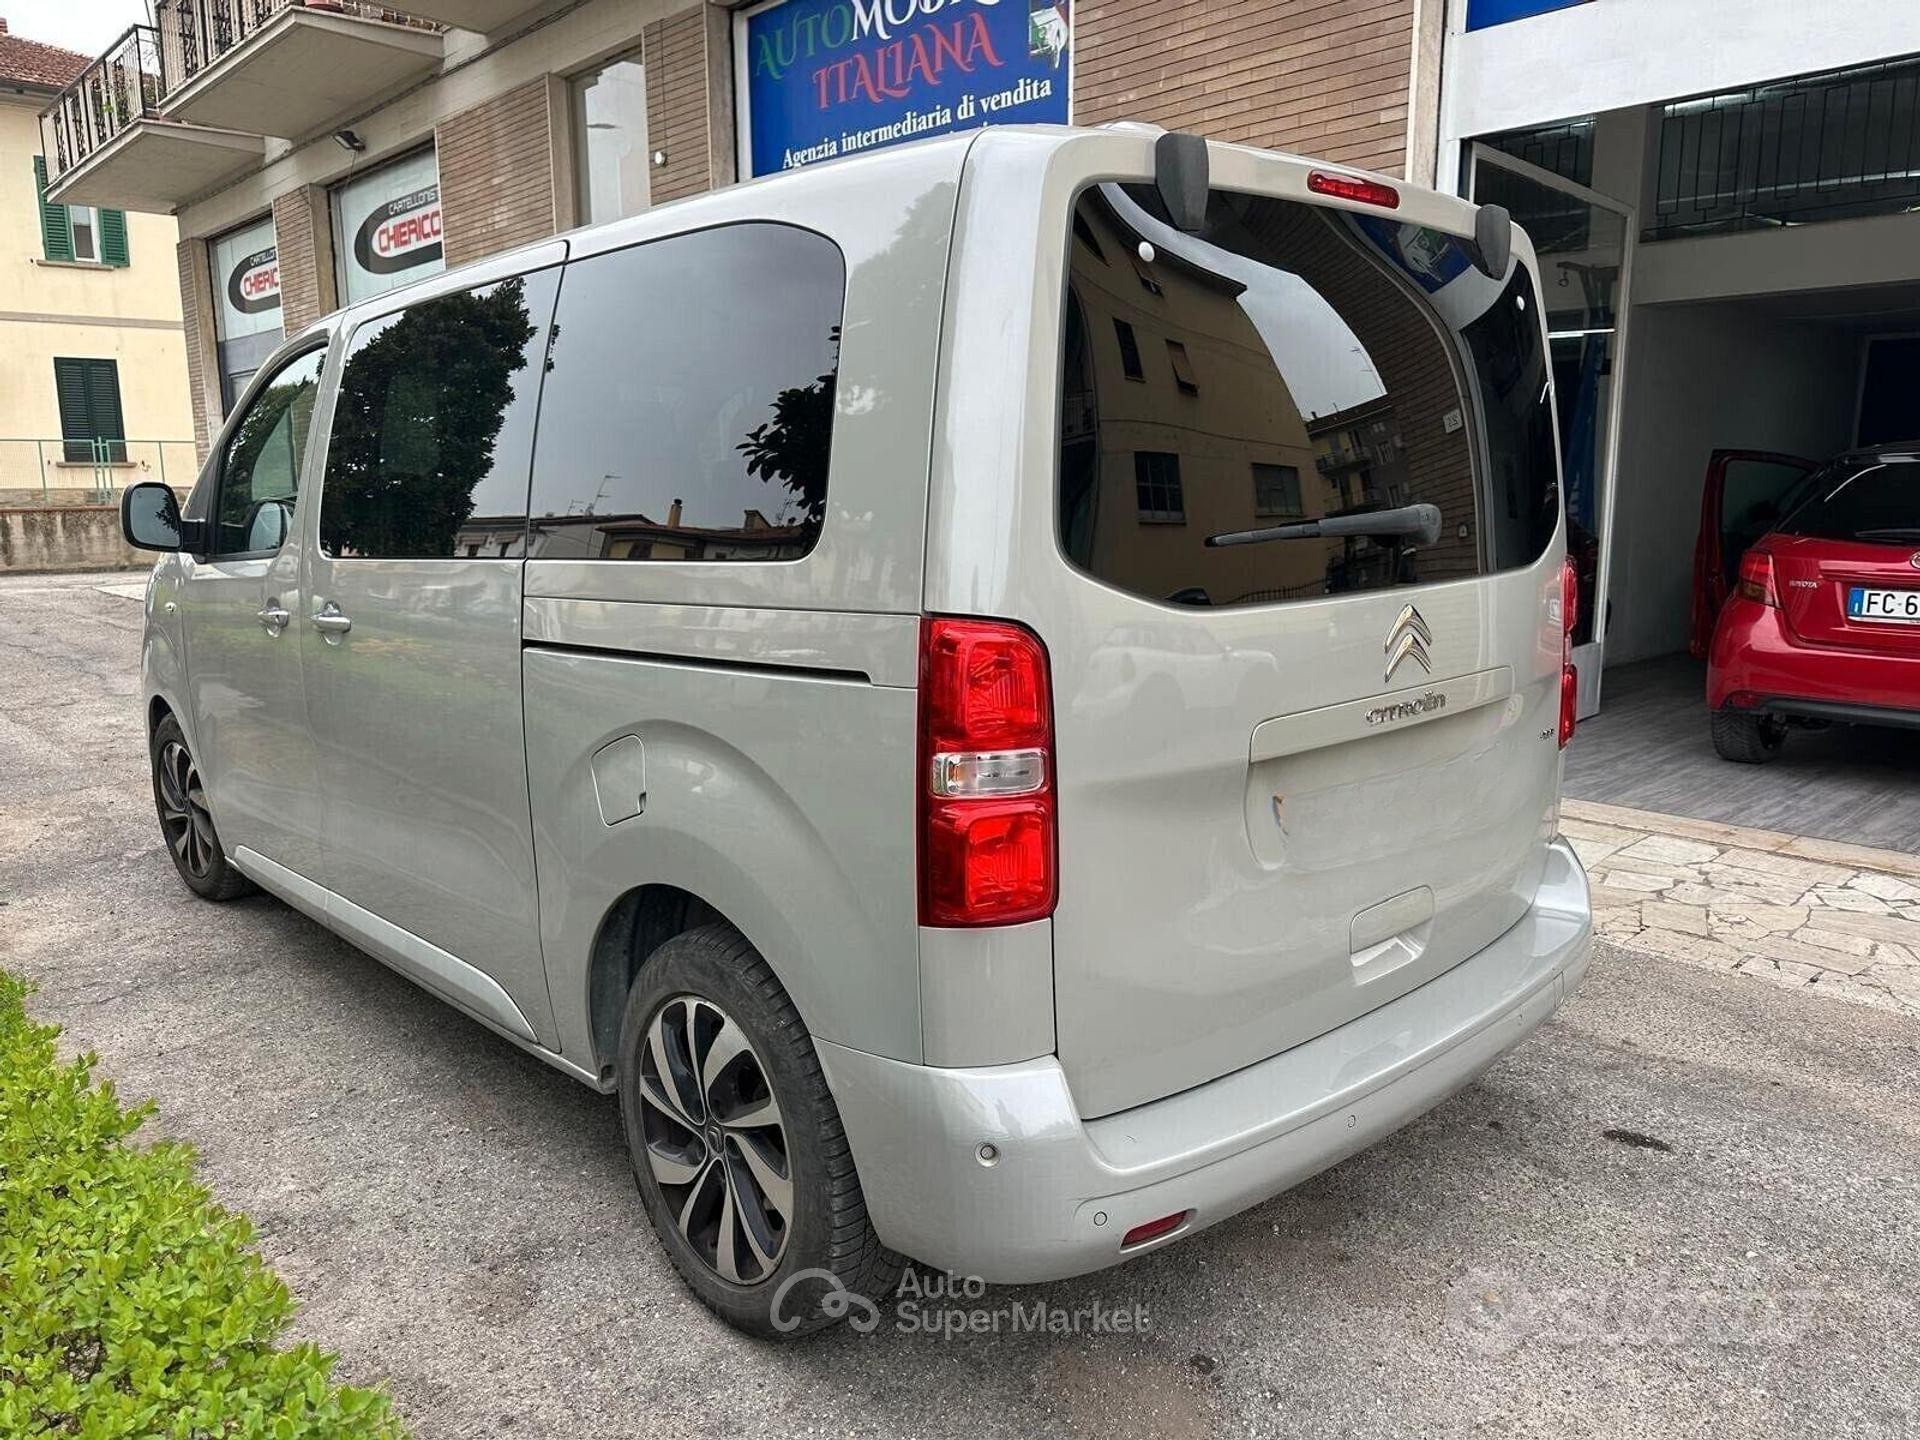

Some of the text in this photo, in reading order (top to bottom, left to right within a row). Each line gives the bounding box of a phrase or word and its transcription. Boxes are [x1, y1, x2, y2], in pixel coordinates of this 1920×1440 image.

[812, 12, 1005, 110] ITALIANA
[782, 139, 838, 169] Agenzia
[842, 104, 952, 152] intermediaria
[957, 94, 976, 120] di
[980, 77, 1052, 114] vendita
[388, 188, 439, 215] CARTELLONIS
